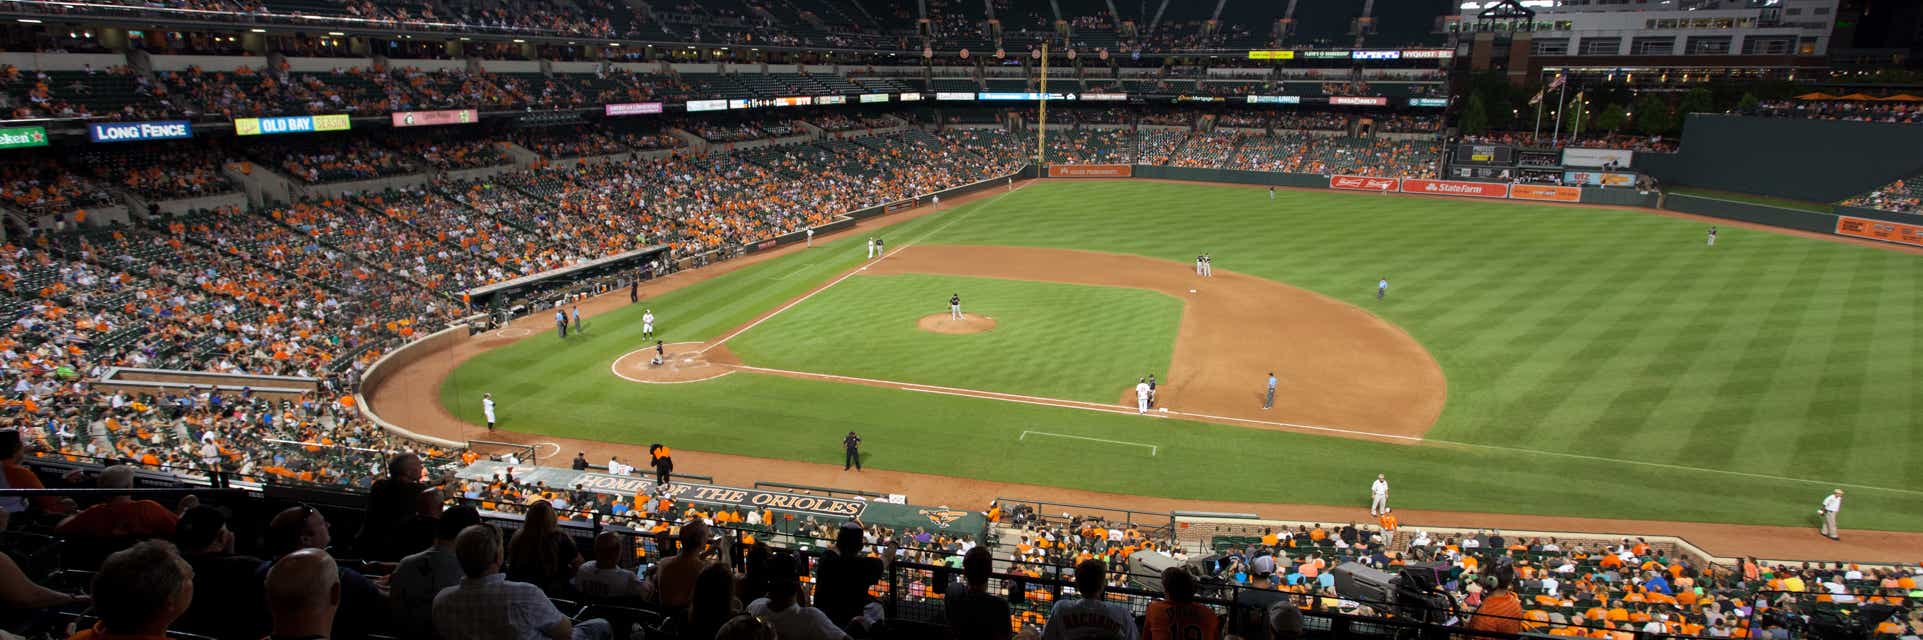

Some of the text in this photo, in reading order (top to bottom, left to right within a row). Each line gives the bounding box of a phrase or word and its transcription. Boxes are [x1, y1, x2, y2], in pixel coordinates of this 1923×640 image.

[96, 123, 187, 139] LONG FENCE
[262, 118, 287, 132] OLD
[288, 117, 310, 131] BAY
[575, 475, 652, 493] HOME
[693, 486, 748, 503] THE
[751, 492, 862, 515] ORIOLES
